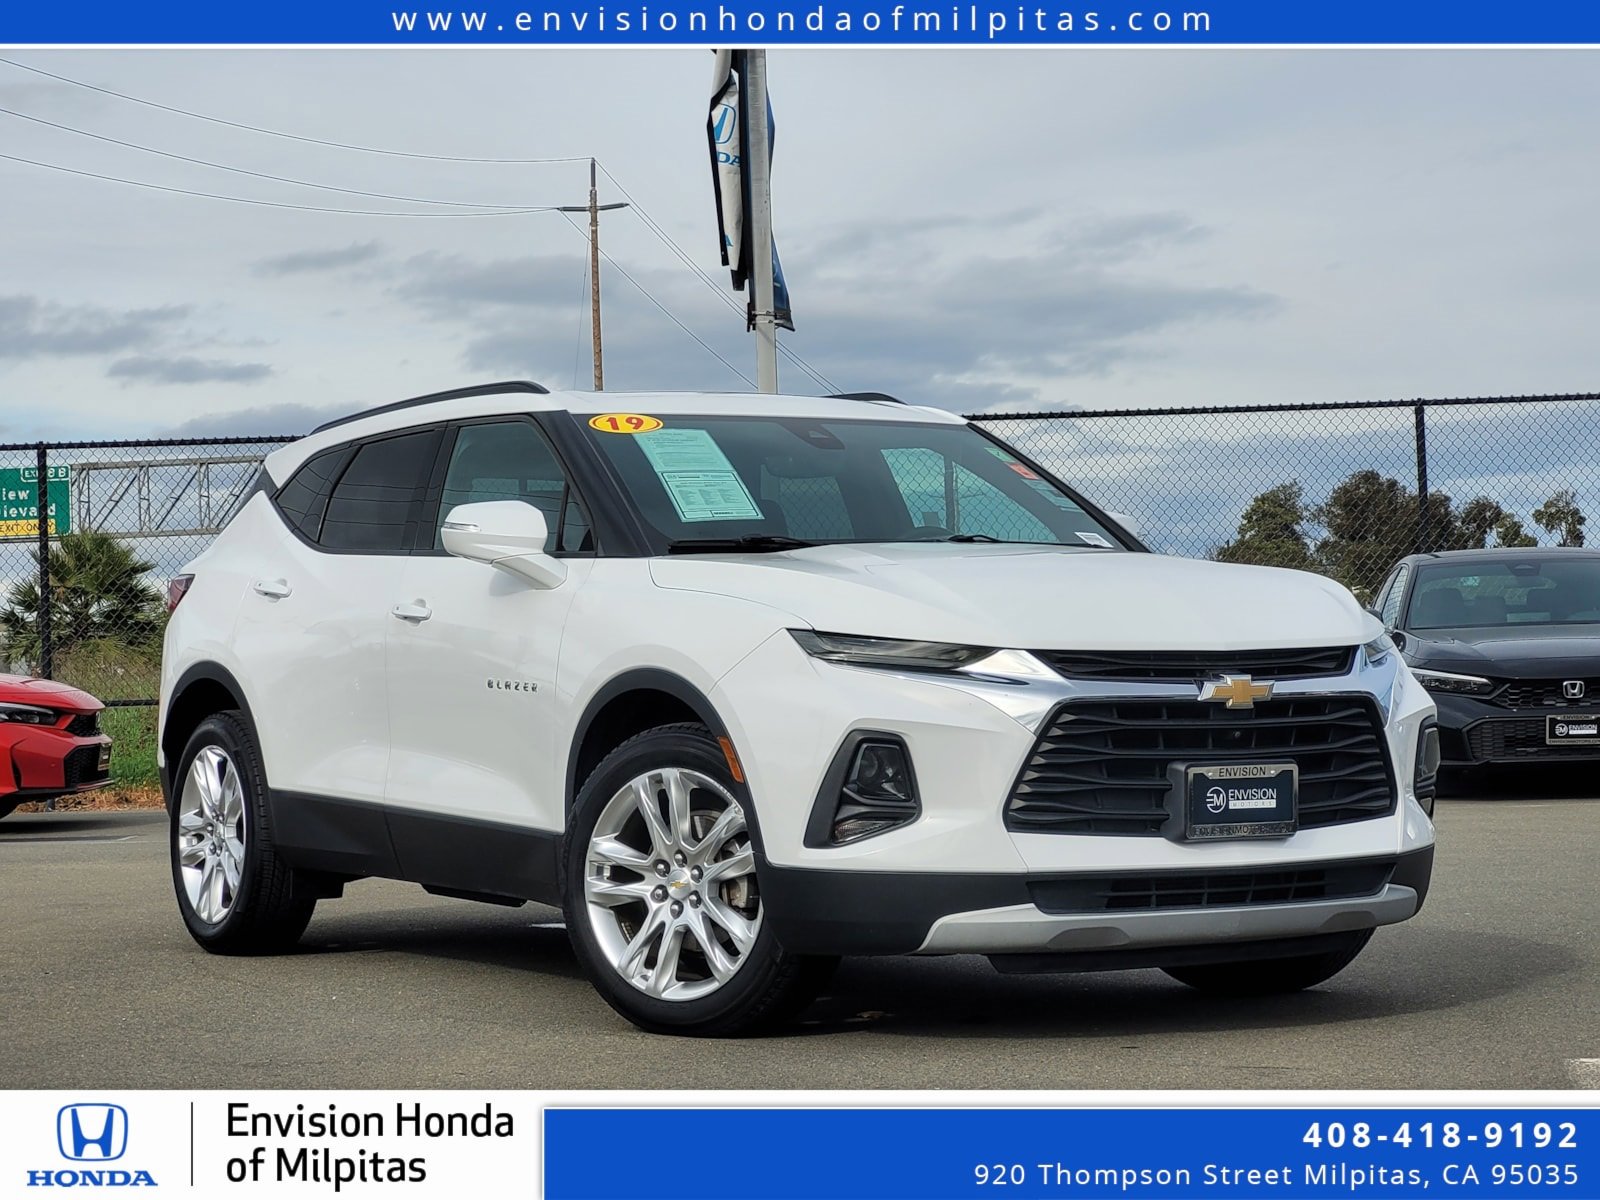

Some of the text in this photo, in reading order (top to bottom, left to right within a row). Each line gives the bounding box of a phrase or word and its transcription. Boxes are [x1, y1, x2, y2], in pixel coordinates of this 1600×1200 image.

[606, 416, 644, 431] 19
[26, 521, 55, 532] ONY
[487, 679, 538, 692] BLAZER
[1218, 767, 1266, 777] ENVISION
[1228, 788, 1277, 800] ENVISION
